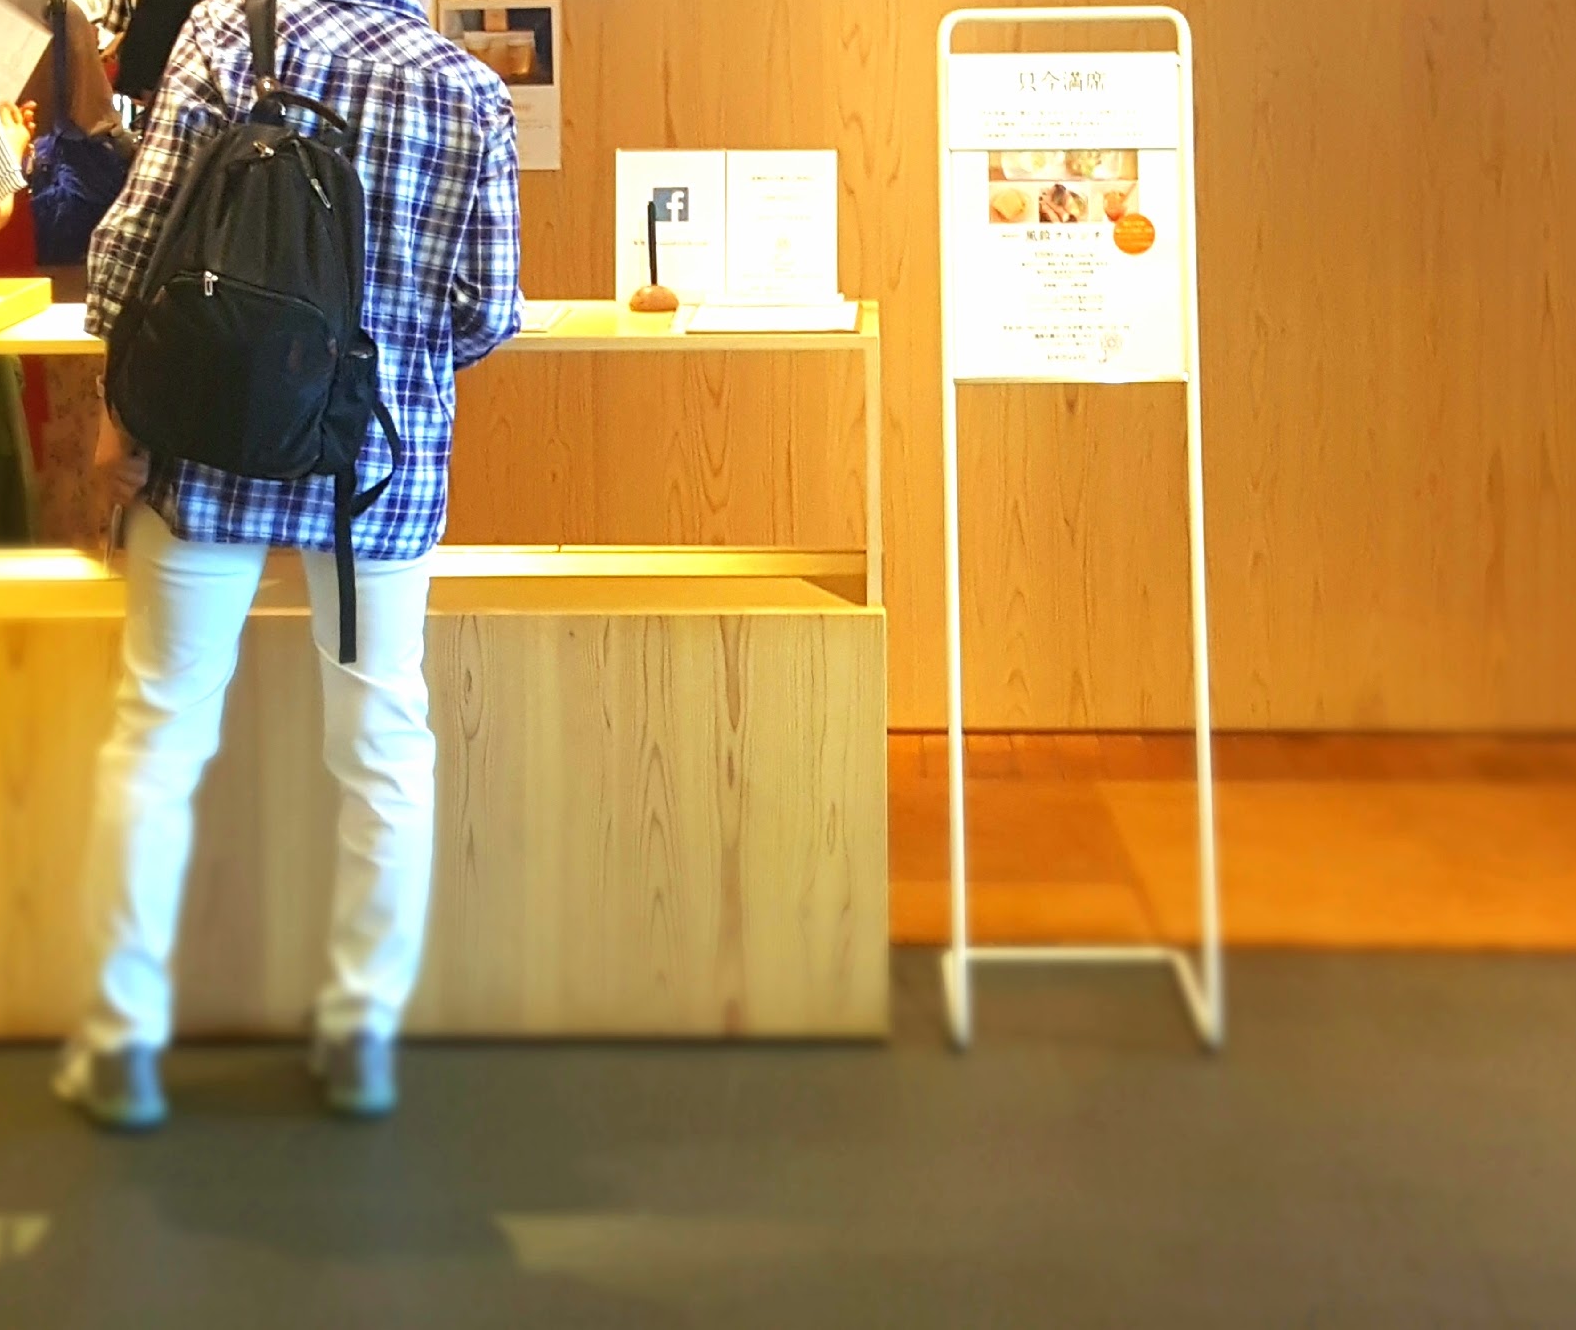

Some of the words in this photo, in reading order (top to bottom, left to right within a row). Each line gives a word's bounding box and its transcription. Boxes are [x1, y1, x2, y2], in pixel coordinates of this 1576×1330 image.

[1018, 70, 1107, 92] 只今満席
[666, 191, 684, 222] f
